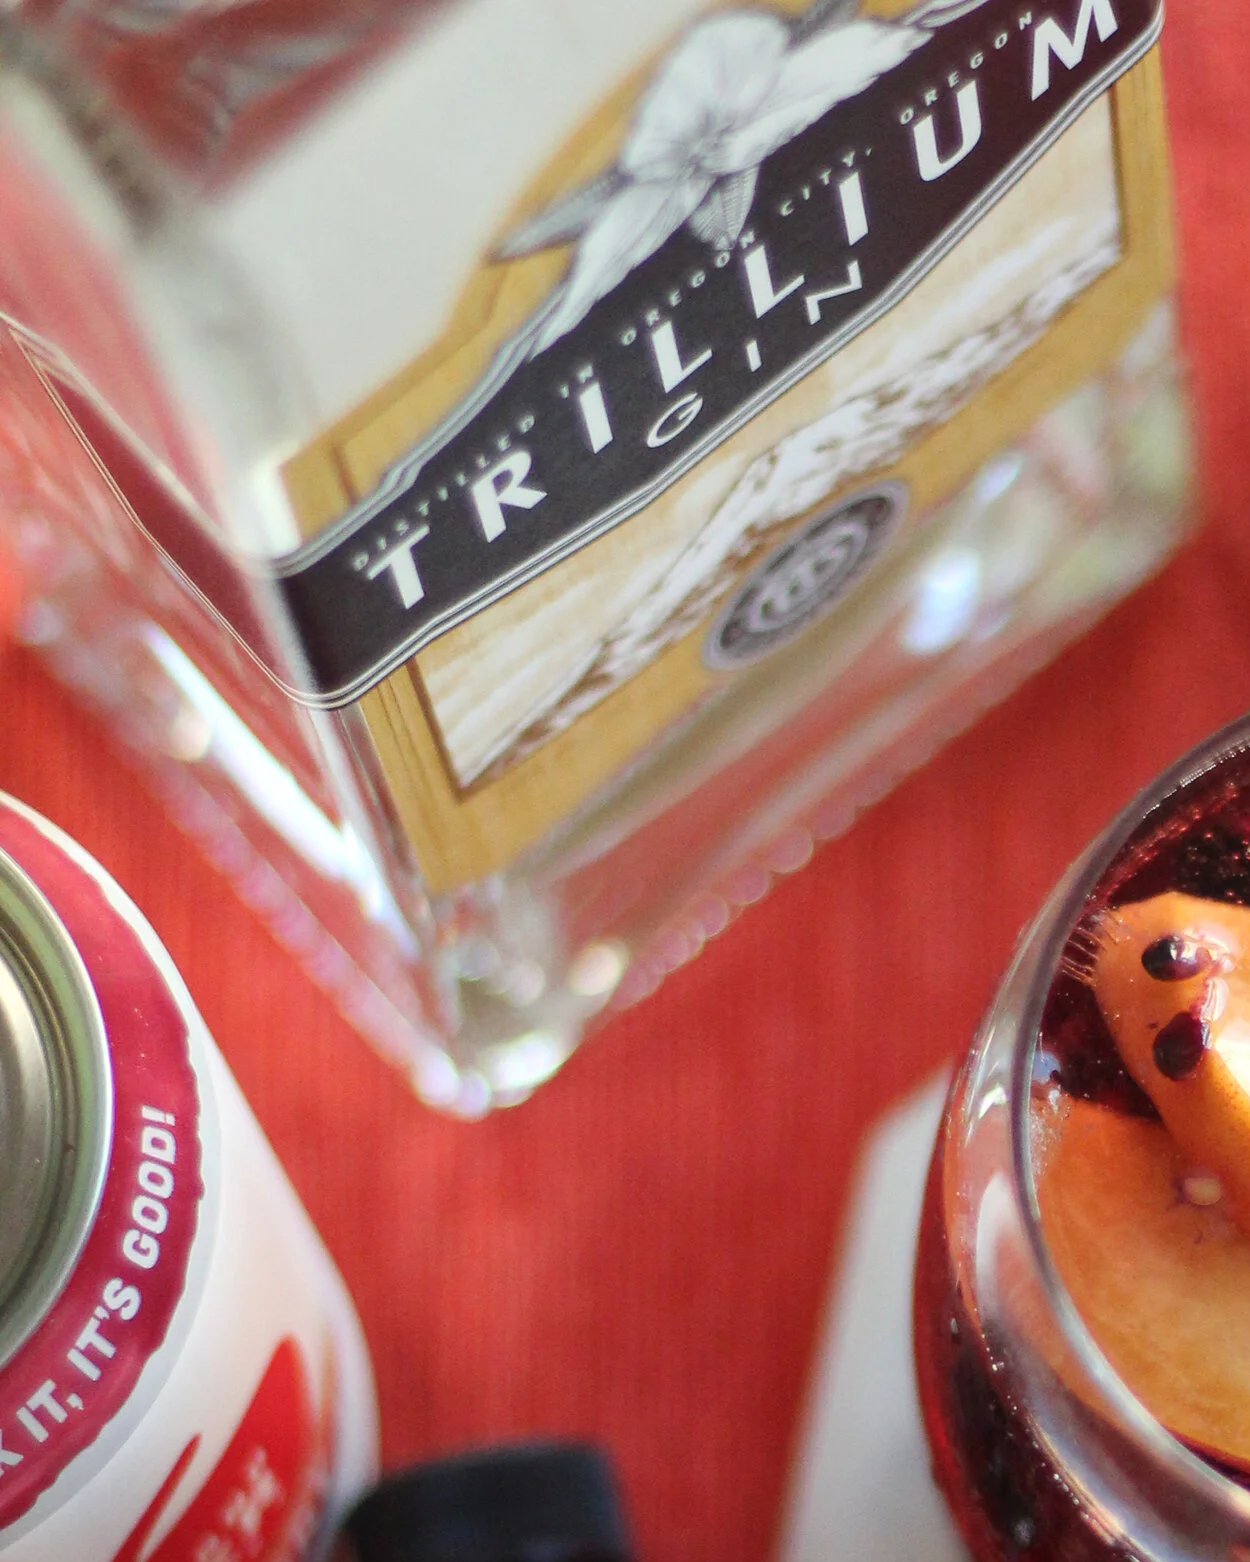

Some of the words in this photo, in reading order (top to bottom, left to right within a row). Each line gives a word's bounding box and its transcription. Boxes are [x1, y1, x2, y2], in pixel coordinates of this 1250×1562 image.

[353, 415, 536, 571] DISTILLED
[560, 364, 594, 399] IN
[621, 230, 755, 346] OREGON
[899, 11, 1033, 125] OREGON
[366, 0, 1119, 610] TRILLIUM
[647, 260, 863, 448] GIN
[16, 1378, 85, 1444] IT,
[67, 1277, 143, 1382] IT'S
[121, 1104, 177, 1271] GOOD!
